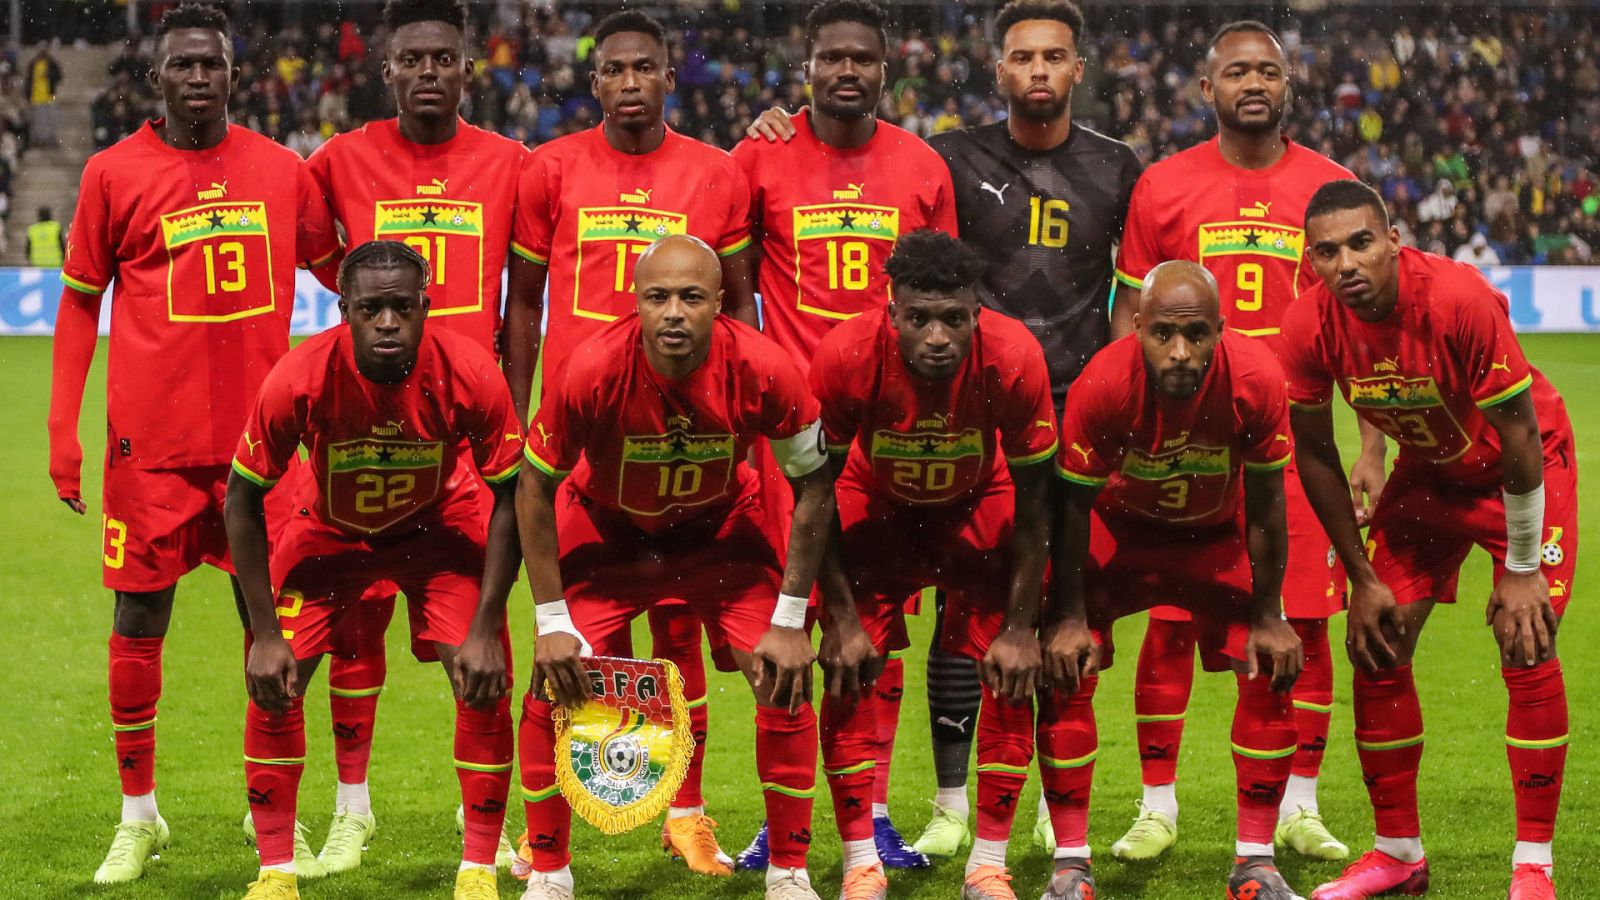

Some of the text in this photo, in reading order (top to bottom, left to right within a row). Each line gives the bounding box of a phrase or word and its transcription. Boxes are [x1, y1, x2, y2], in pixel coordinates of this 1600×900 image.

[197, 189, 223, 200] PUMA
[416, 185, 442, 195] PUMA
[620, 193, 646, 204] PUMA
[833, 190, 859, 199] PUMA
[1028, 196, 1069, 248] 16
[1239, 207, 1265, 217] PUMA
[203, 241, 247, 294] 13
[826, 241, 869, 290] 18
[1236, 263, 1263, 312] 9
[371, 425, 397, 436] PUMA
[916, 419, 943, 429] PUMA
[657, 463, 703, 497] 10
[893, 460, 956, 491] 20
[355, 473, 416, 514] 22
[1157, 479, 1188, 510] 3
[102, 513, 127, 570] 3
[586, 671, 657, 702] GFA
